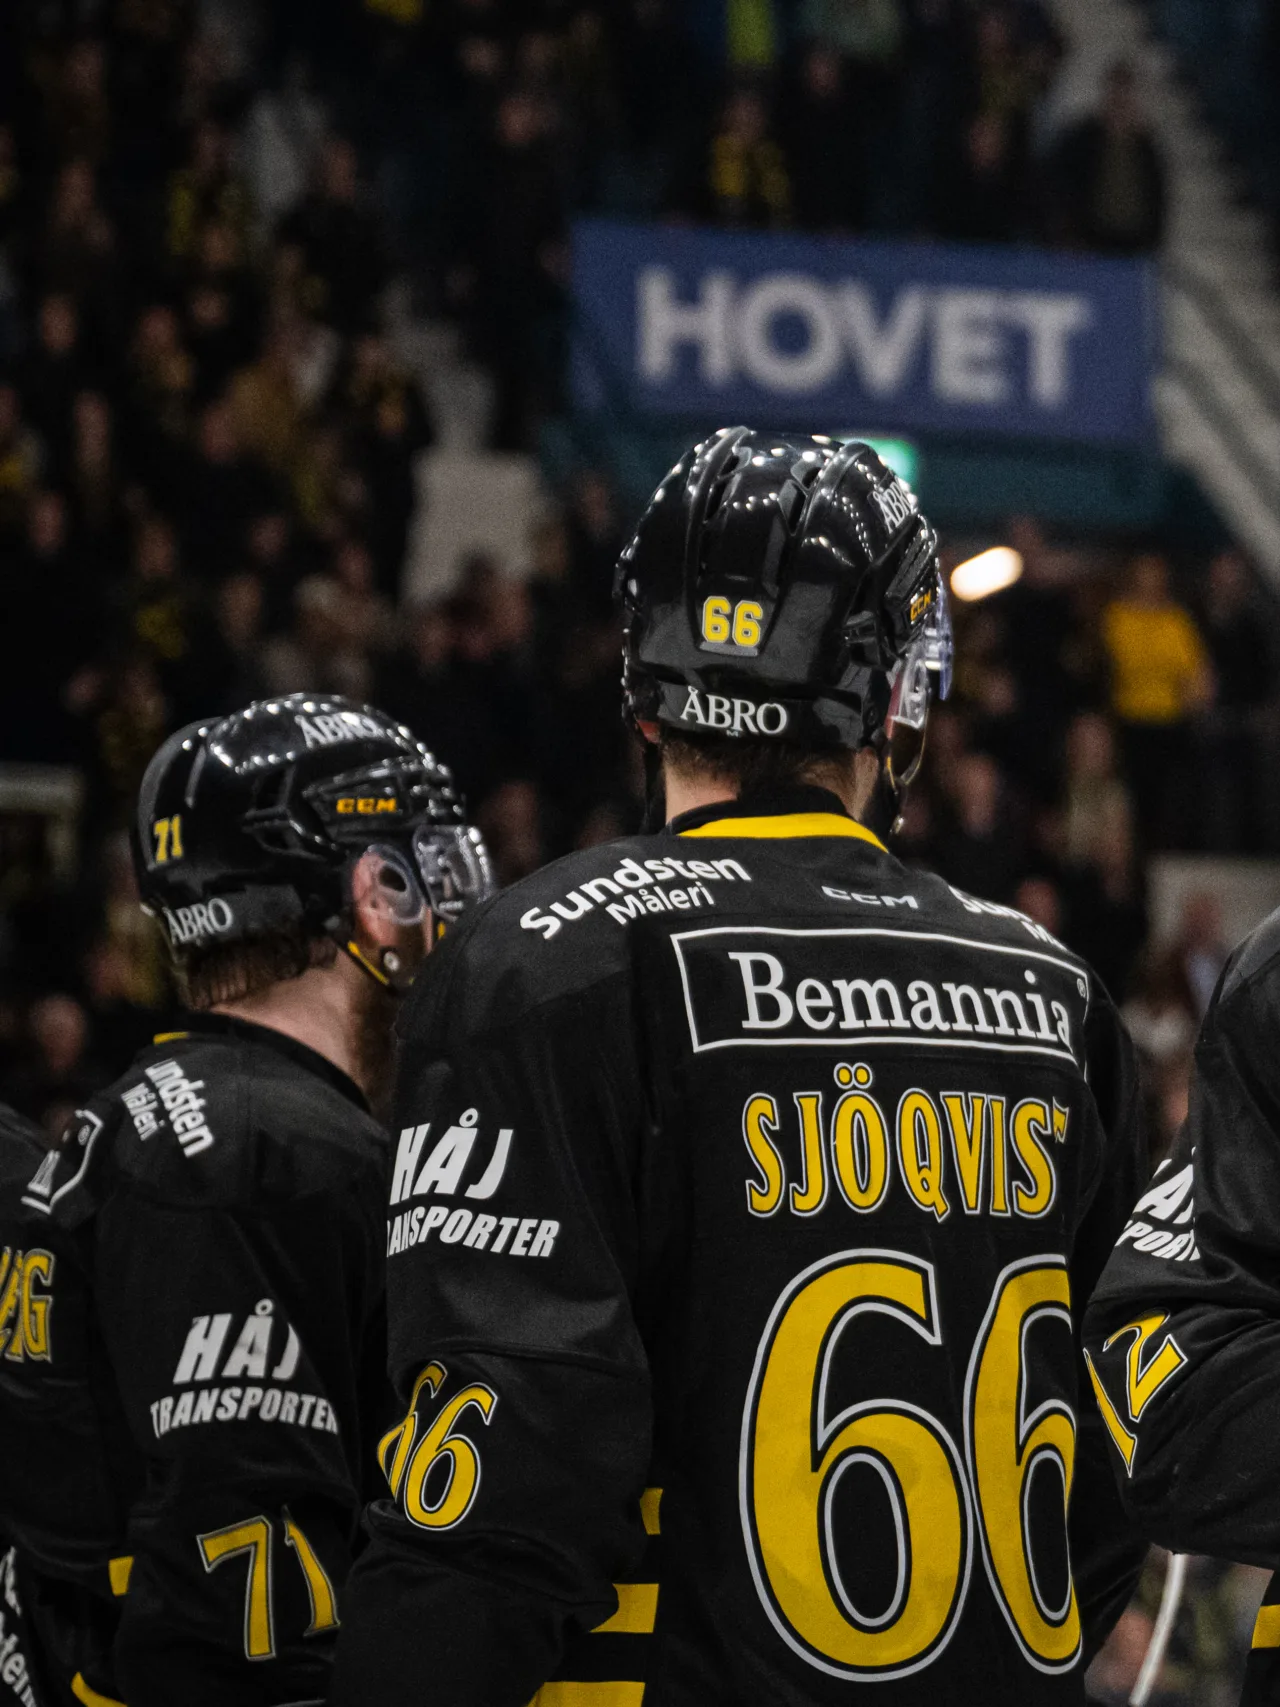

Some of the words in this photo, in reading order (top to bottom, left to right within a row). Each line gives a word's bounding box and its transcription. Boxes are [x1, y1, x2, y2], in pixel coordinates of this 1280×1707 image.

[634, 262, 1094, 408] HOVET
[872, 477, 918, 534] ÅBR
[701, 595, 764, 648] 66
[910, 590, 932, 621] CCM
[679, 685, 788, 736] ÅBRO
[153, 814, 184, 864] 71
[336, 798, 397, 814] CCM
[519, 857, 752, 940] Sundsten
[604, 881, 715, 926] Måleri
[821, 886, 919, 909] CCM
[728, 951, 1074, 1054] Bemannia
[144, 1058, 215, 1159] undsten
[389, 1107, 514, 1206] HÅJ
[387, 1206, 561, 1258] ANSPORTER
[172, 1298, 301, 1386] HÅJ
[377, 1360, 499, 1532] 66
[738, 1247, 1084, 1684] 66
[196, 1504, 341, 1663] 71
